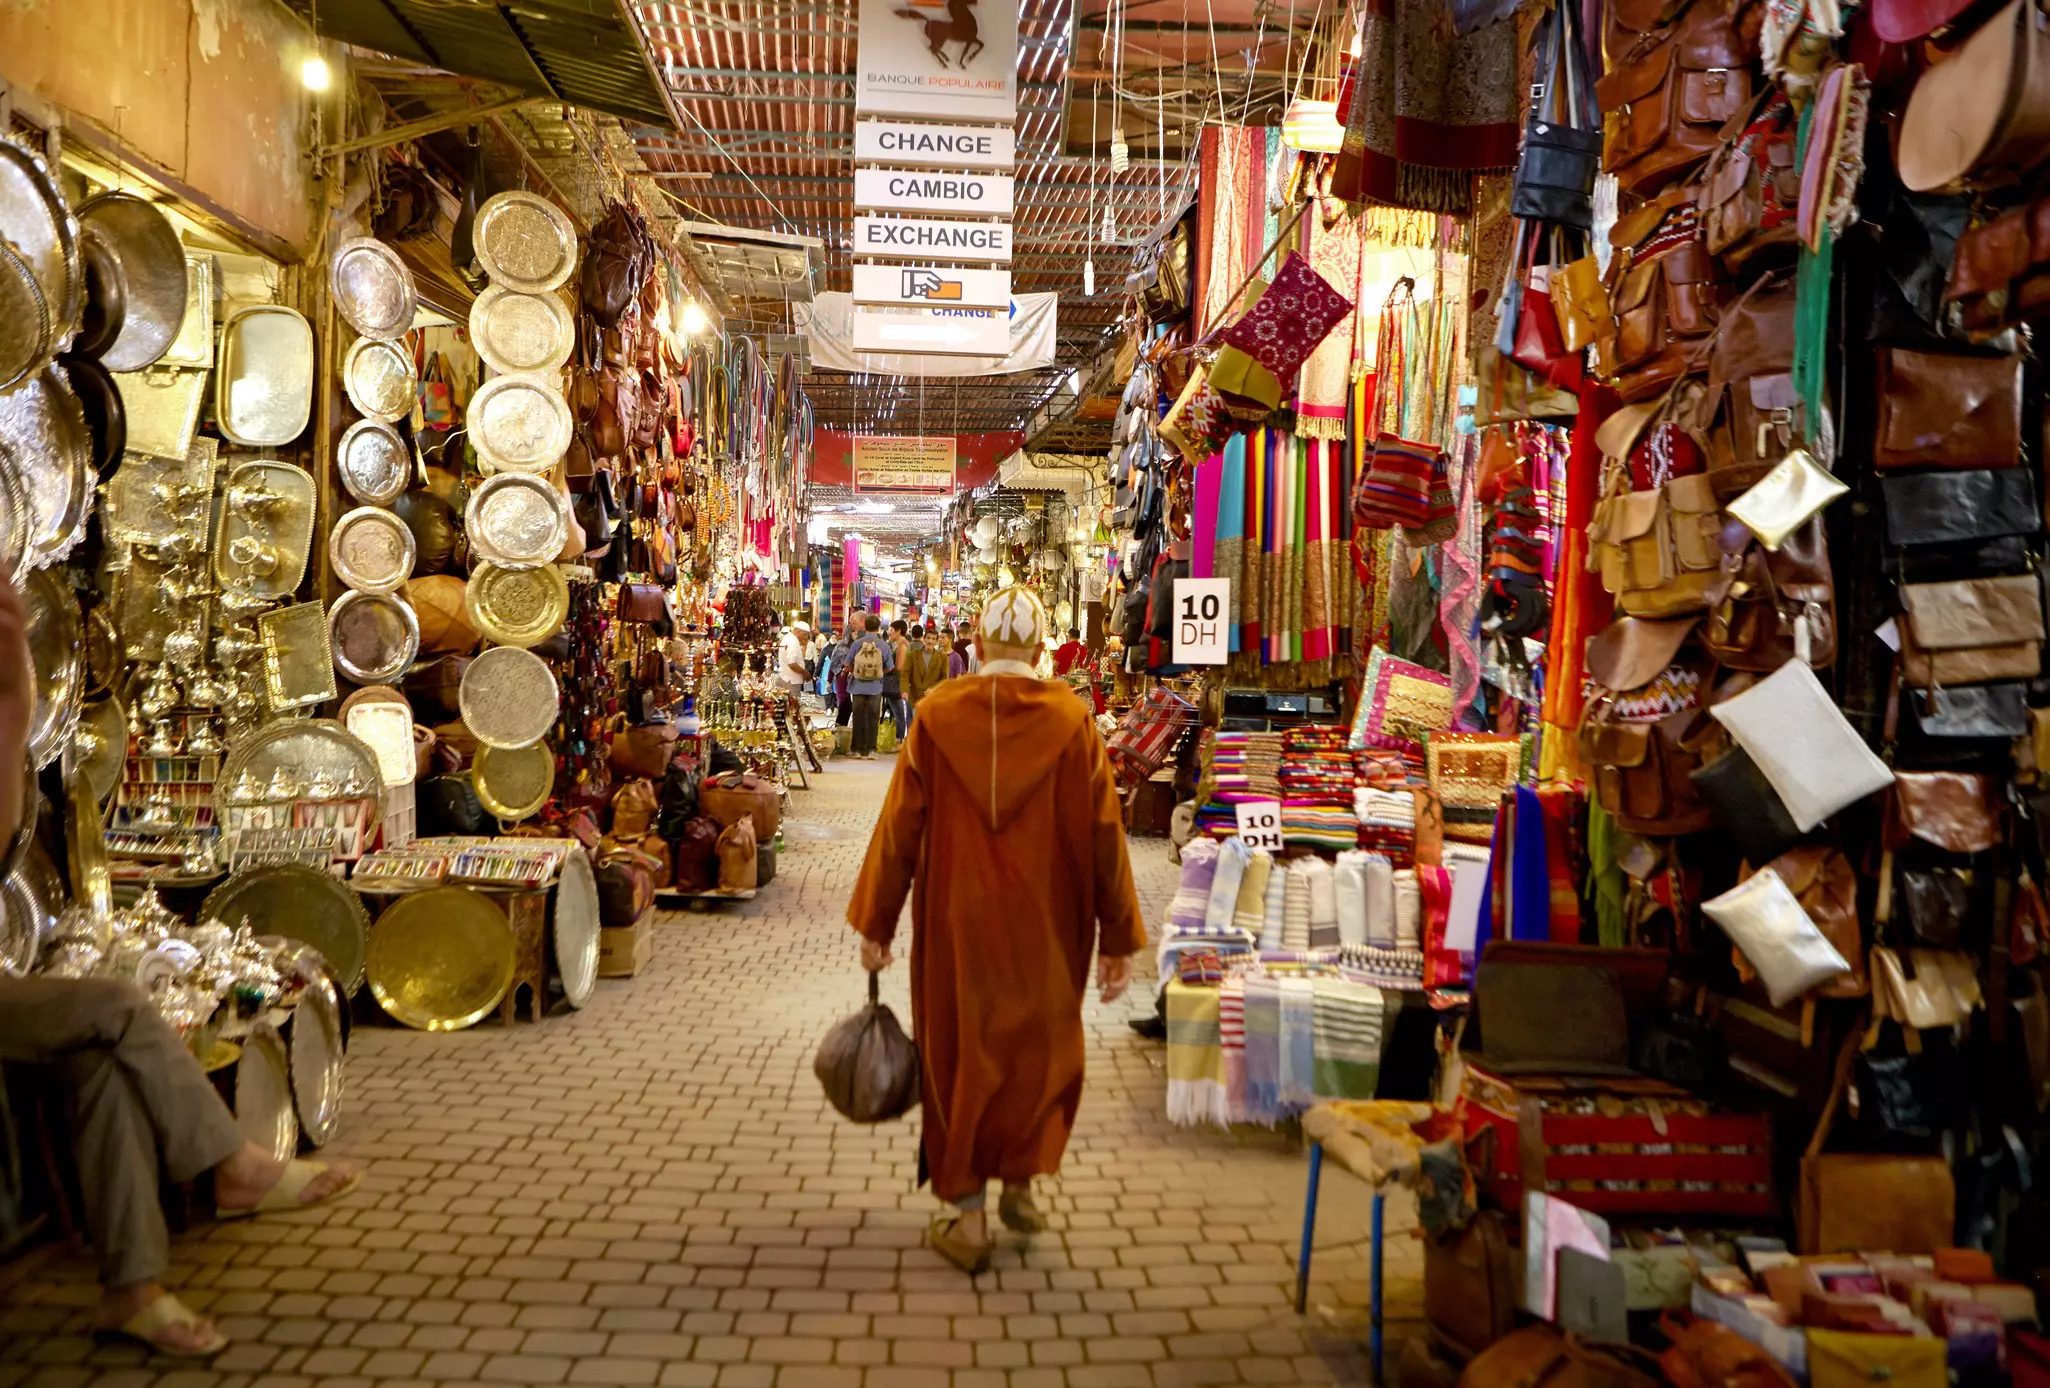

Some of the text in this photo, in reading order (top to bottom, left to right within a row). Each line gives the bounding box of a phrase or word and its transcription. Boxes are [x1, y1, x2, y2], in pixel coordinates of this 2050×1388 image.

[867, 73, 1006, 91] BANQUE POPULAIRE
[879, 132, 992, 154] CHANGE
[889, 178, 984, 200] CAMBIO
[867, 224, 1003, 249] EXCHANGE
[1182, 594, 1220, 620] 10
[1181, 622, 1216, 645] DH
[1246, 814, 1275, 828] 10
[1243, 833, 1279, 847] DH
